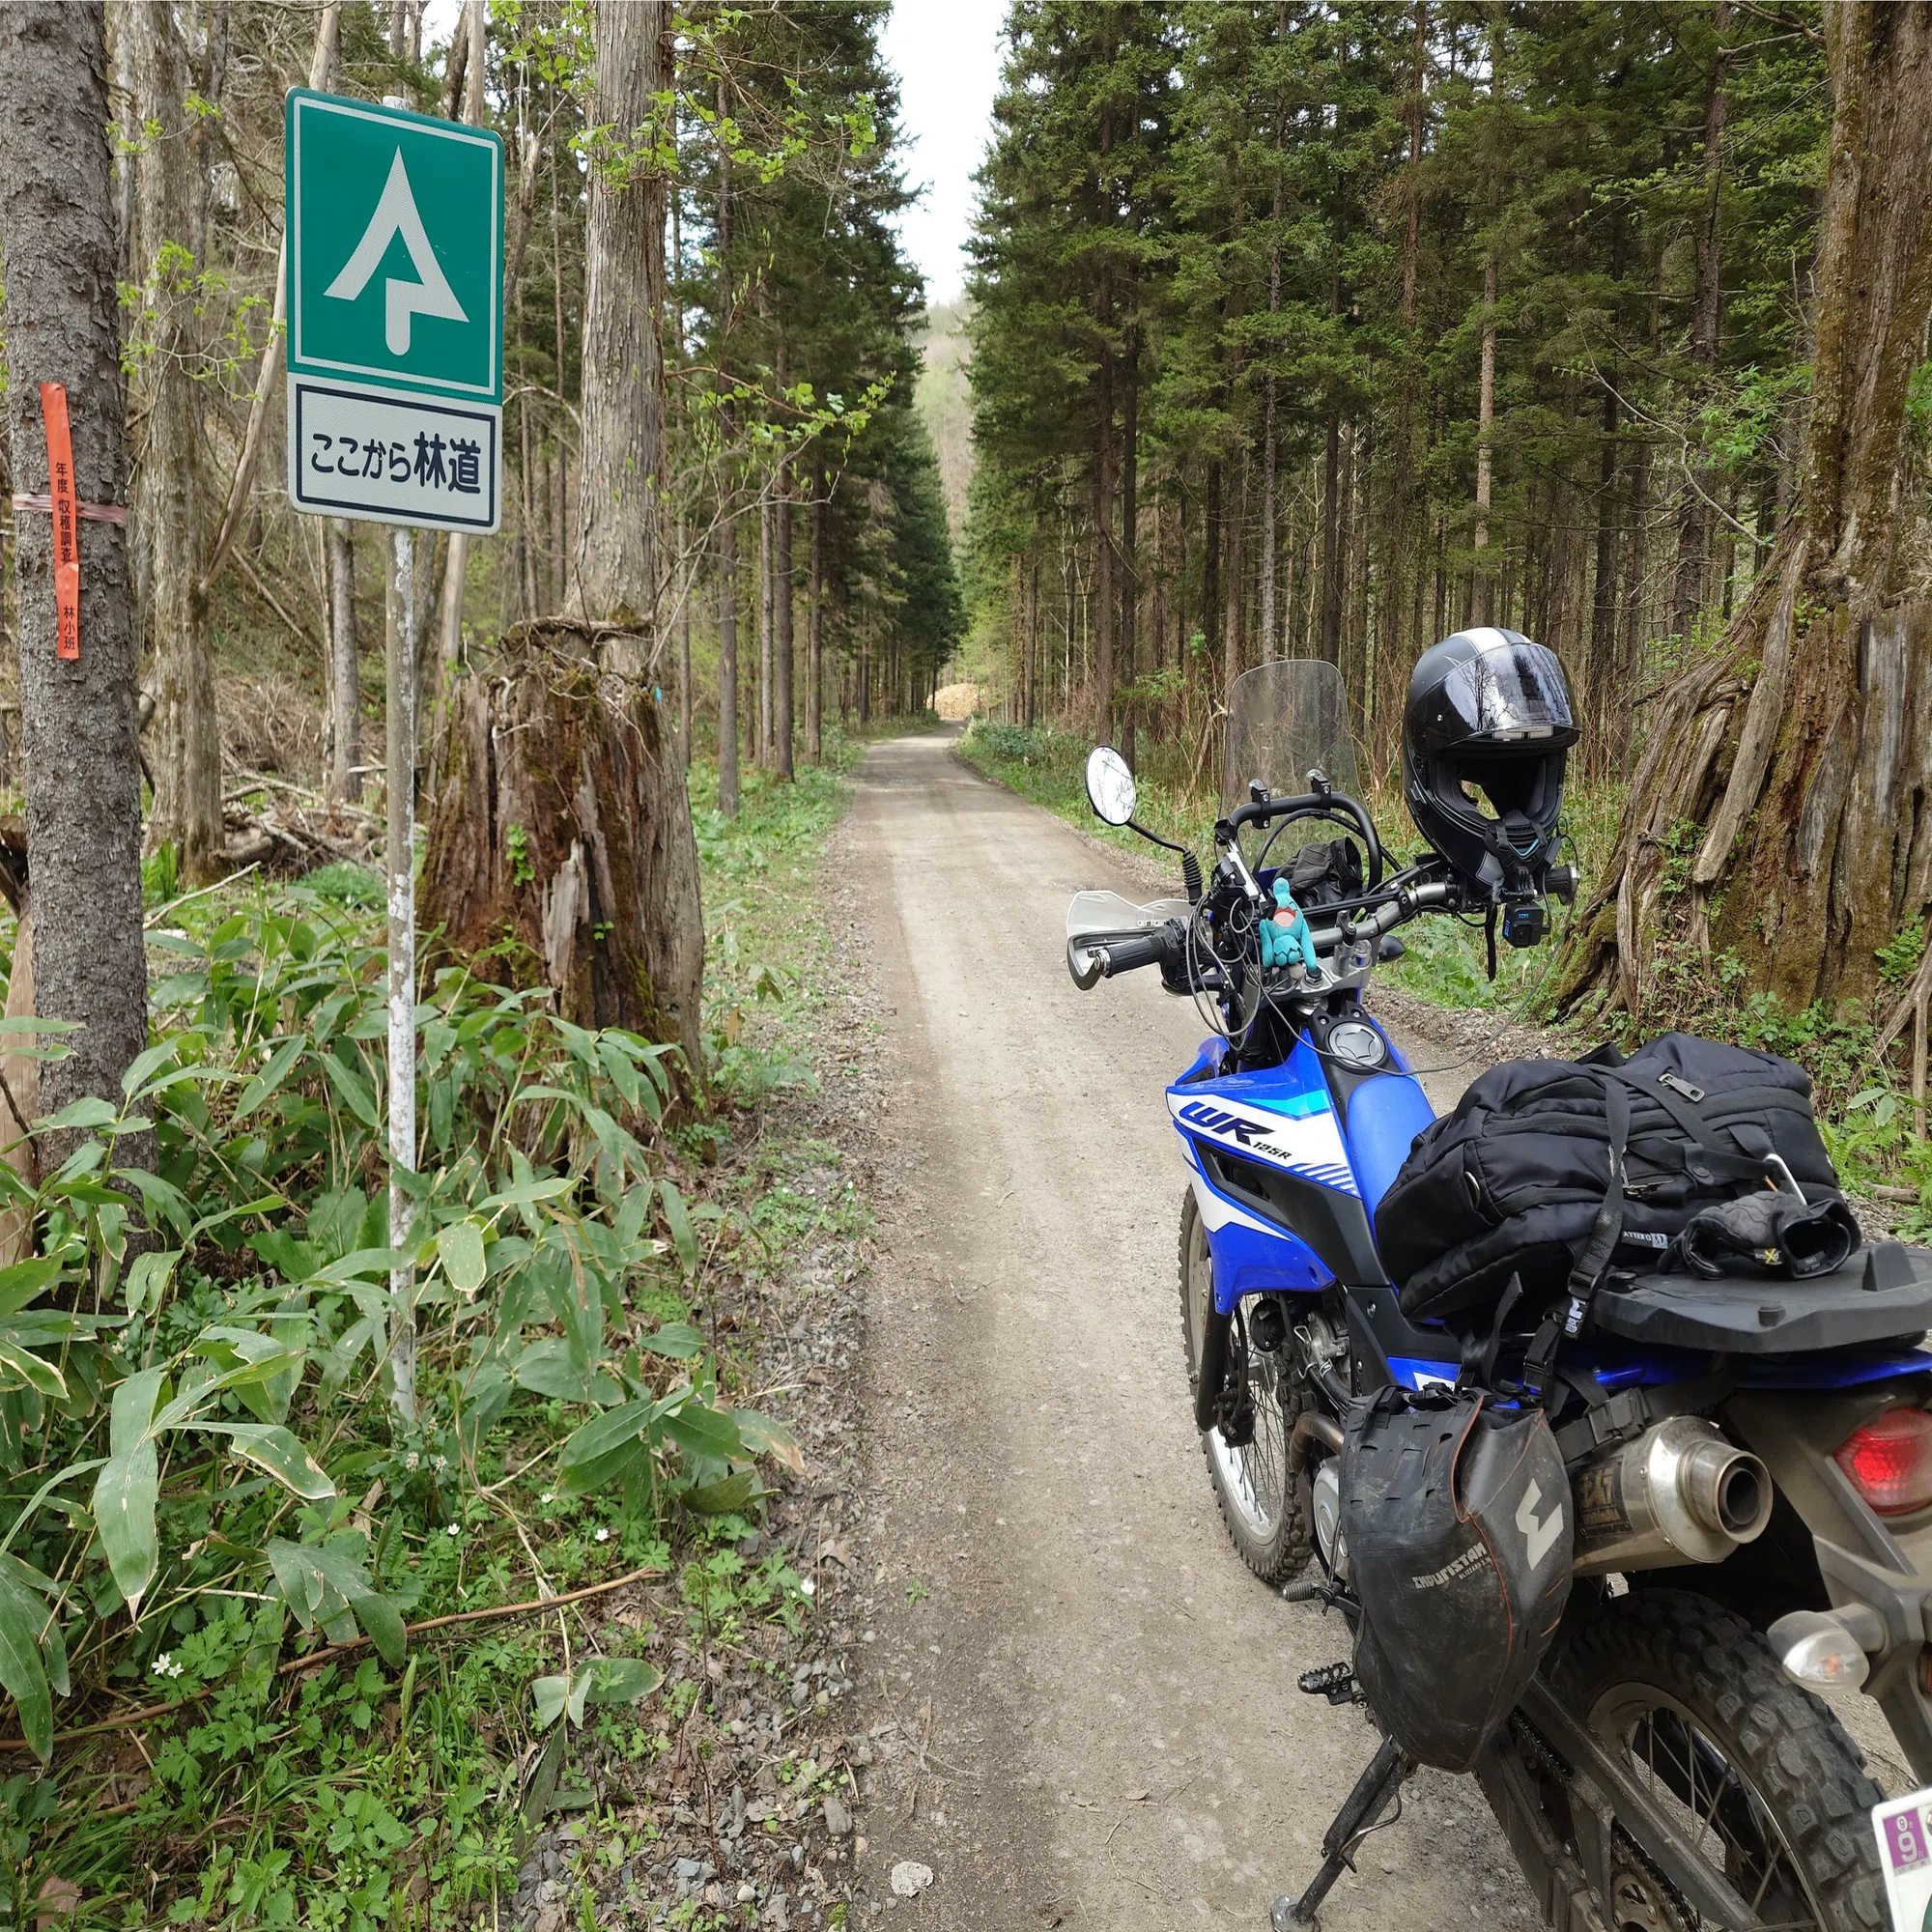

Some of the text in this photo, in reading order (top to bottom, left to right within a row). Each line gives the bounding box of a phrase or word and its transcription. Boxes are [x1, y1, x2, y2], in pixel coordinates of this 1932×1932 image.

[311, 431, 481, 494] ここから林道
[55, 462, 75, 650] 年度 収穫調査 林小班
[1179, 1101, 1293, 1160] WR 125R
[1411, 1542, 1487, 1589] ENDURISTAN
